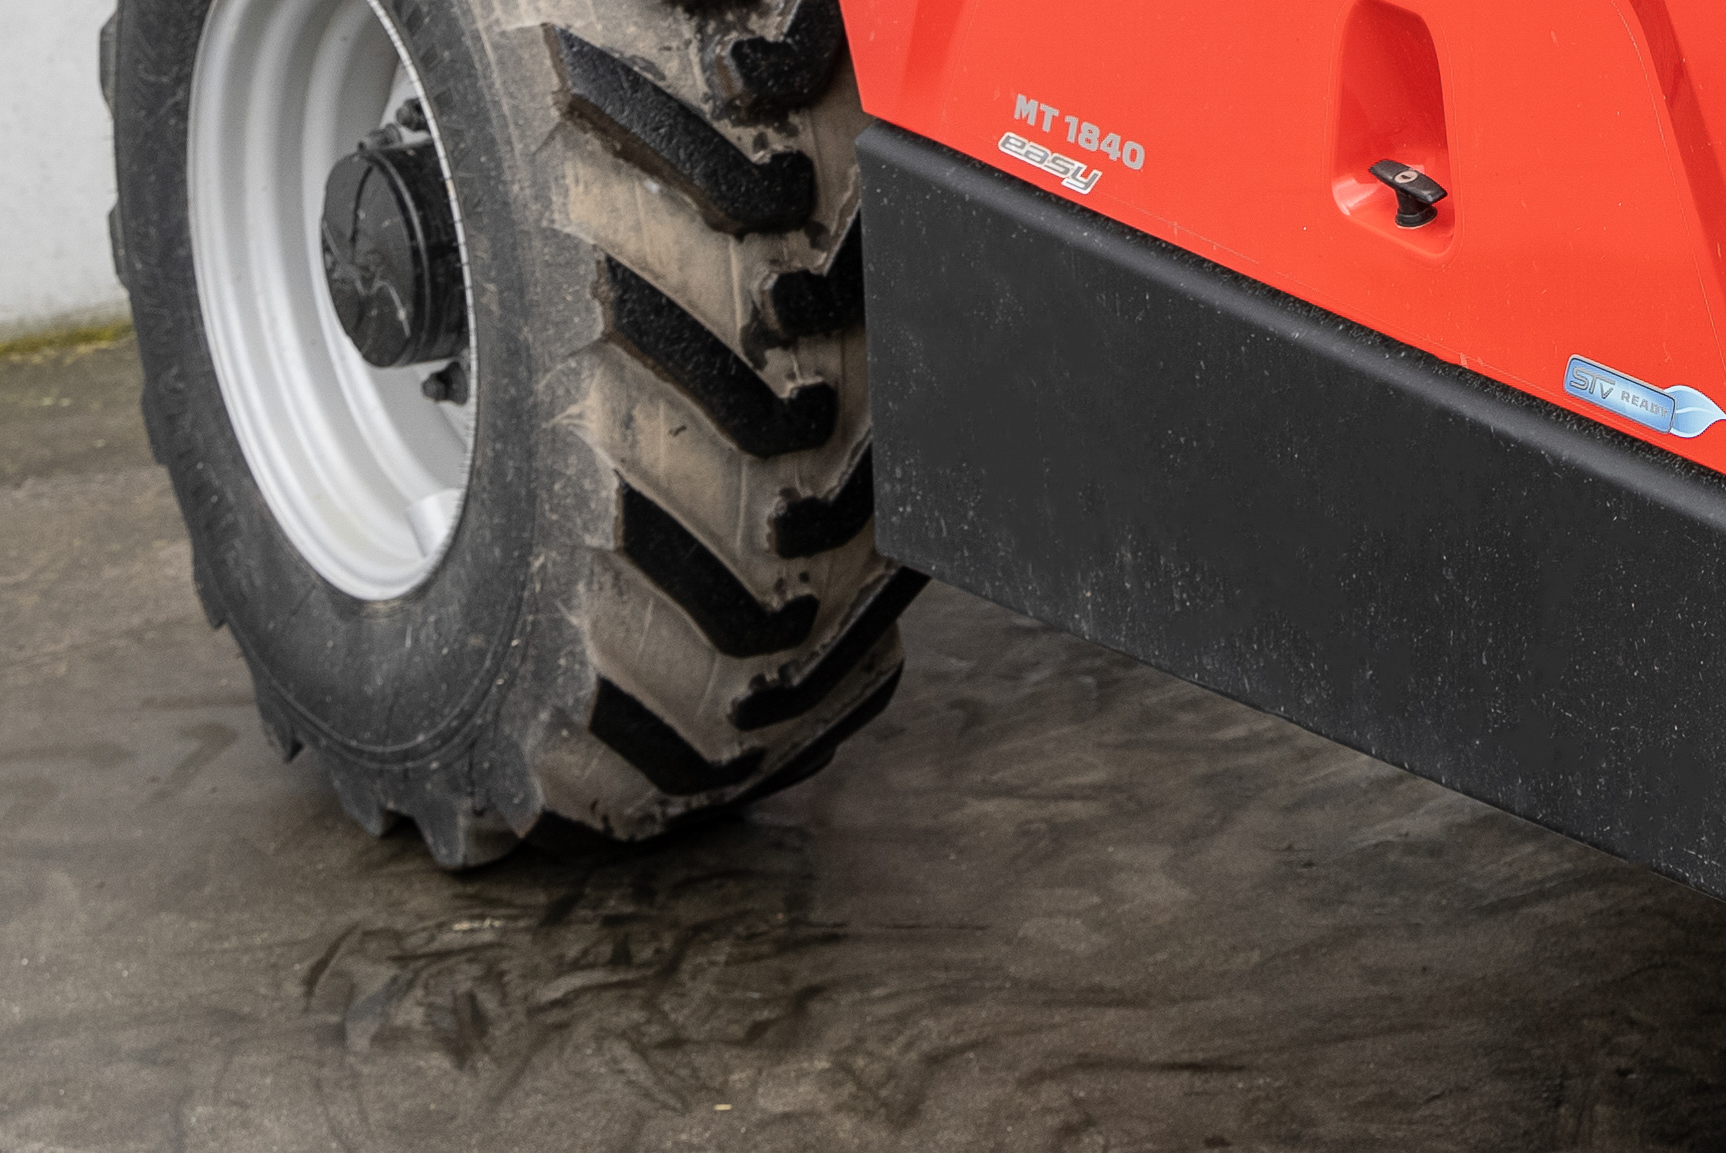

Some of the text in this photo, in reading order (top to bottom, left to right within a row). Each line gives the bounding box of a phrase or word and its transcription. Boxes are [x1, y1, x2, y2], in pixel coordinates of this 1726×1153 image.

[1014, 93, 1145, 170] MT 1840
[999, 133, 1101, 193] easy
[1570, 366, 1669, 418] STV READY
